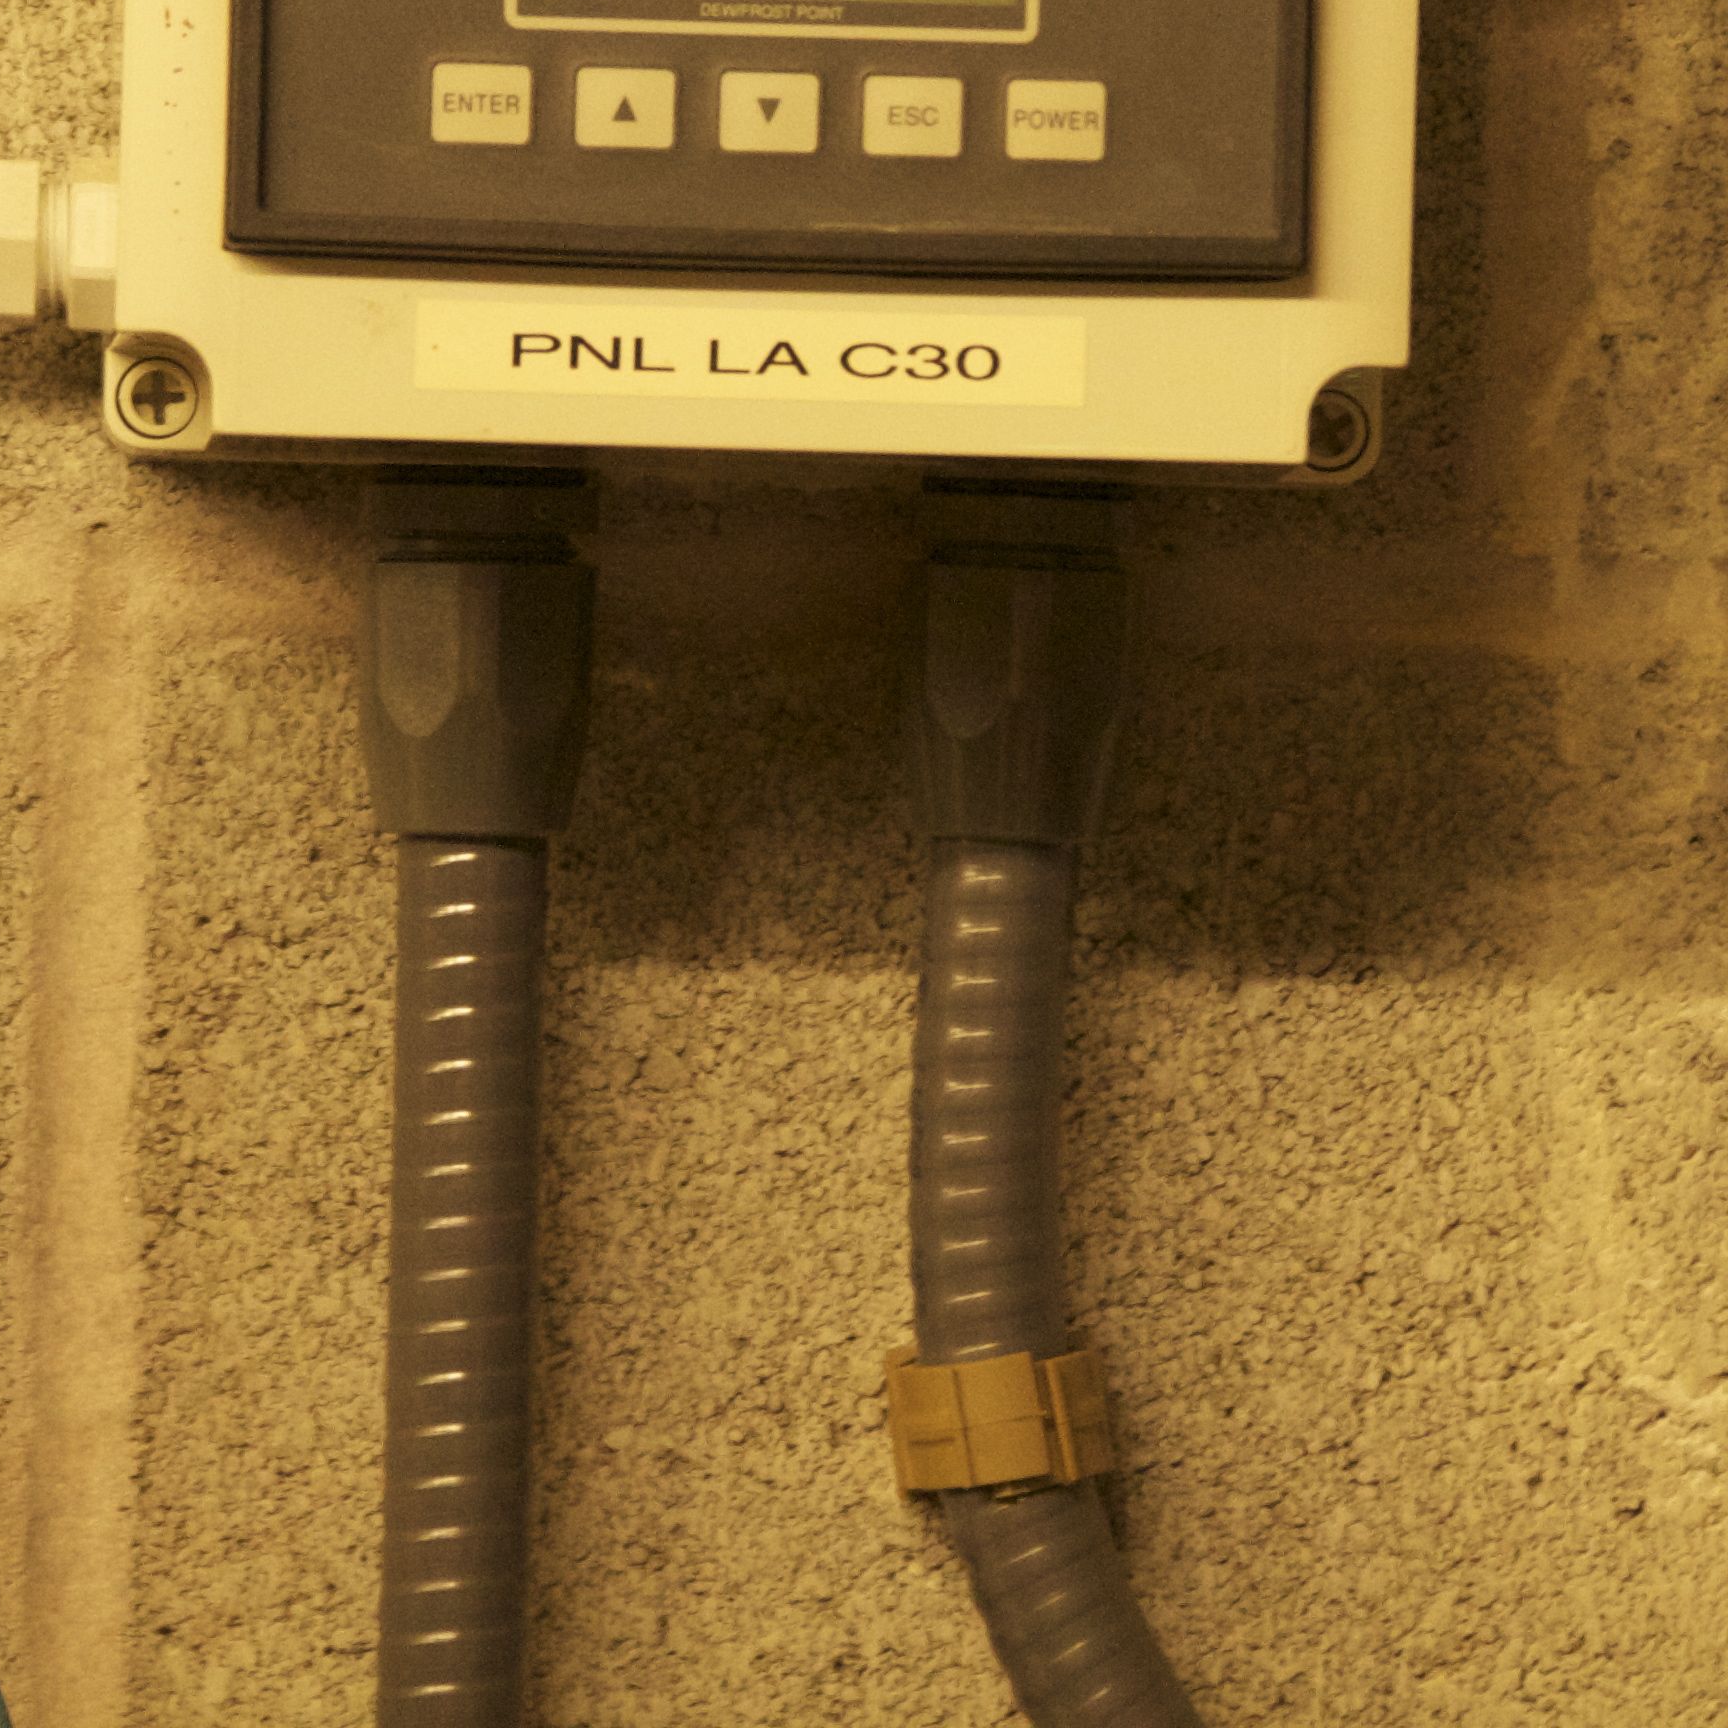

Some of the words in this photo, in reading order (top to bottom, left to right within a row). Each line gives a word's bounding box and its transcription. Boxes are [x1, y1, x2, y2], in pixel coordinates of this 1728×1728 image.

[795, 4, 845, 21] POINT
[442, 92, 521, 116] ENTER
[886, 104, 940, 128] ESC
[1012, 108, 1101, 132] POWER
[511, 333, 676, 372] PNL
[709, 339, 809, 377] LA
[839, 342, 1002, 381] C30
